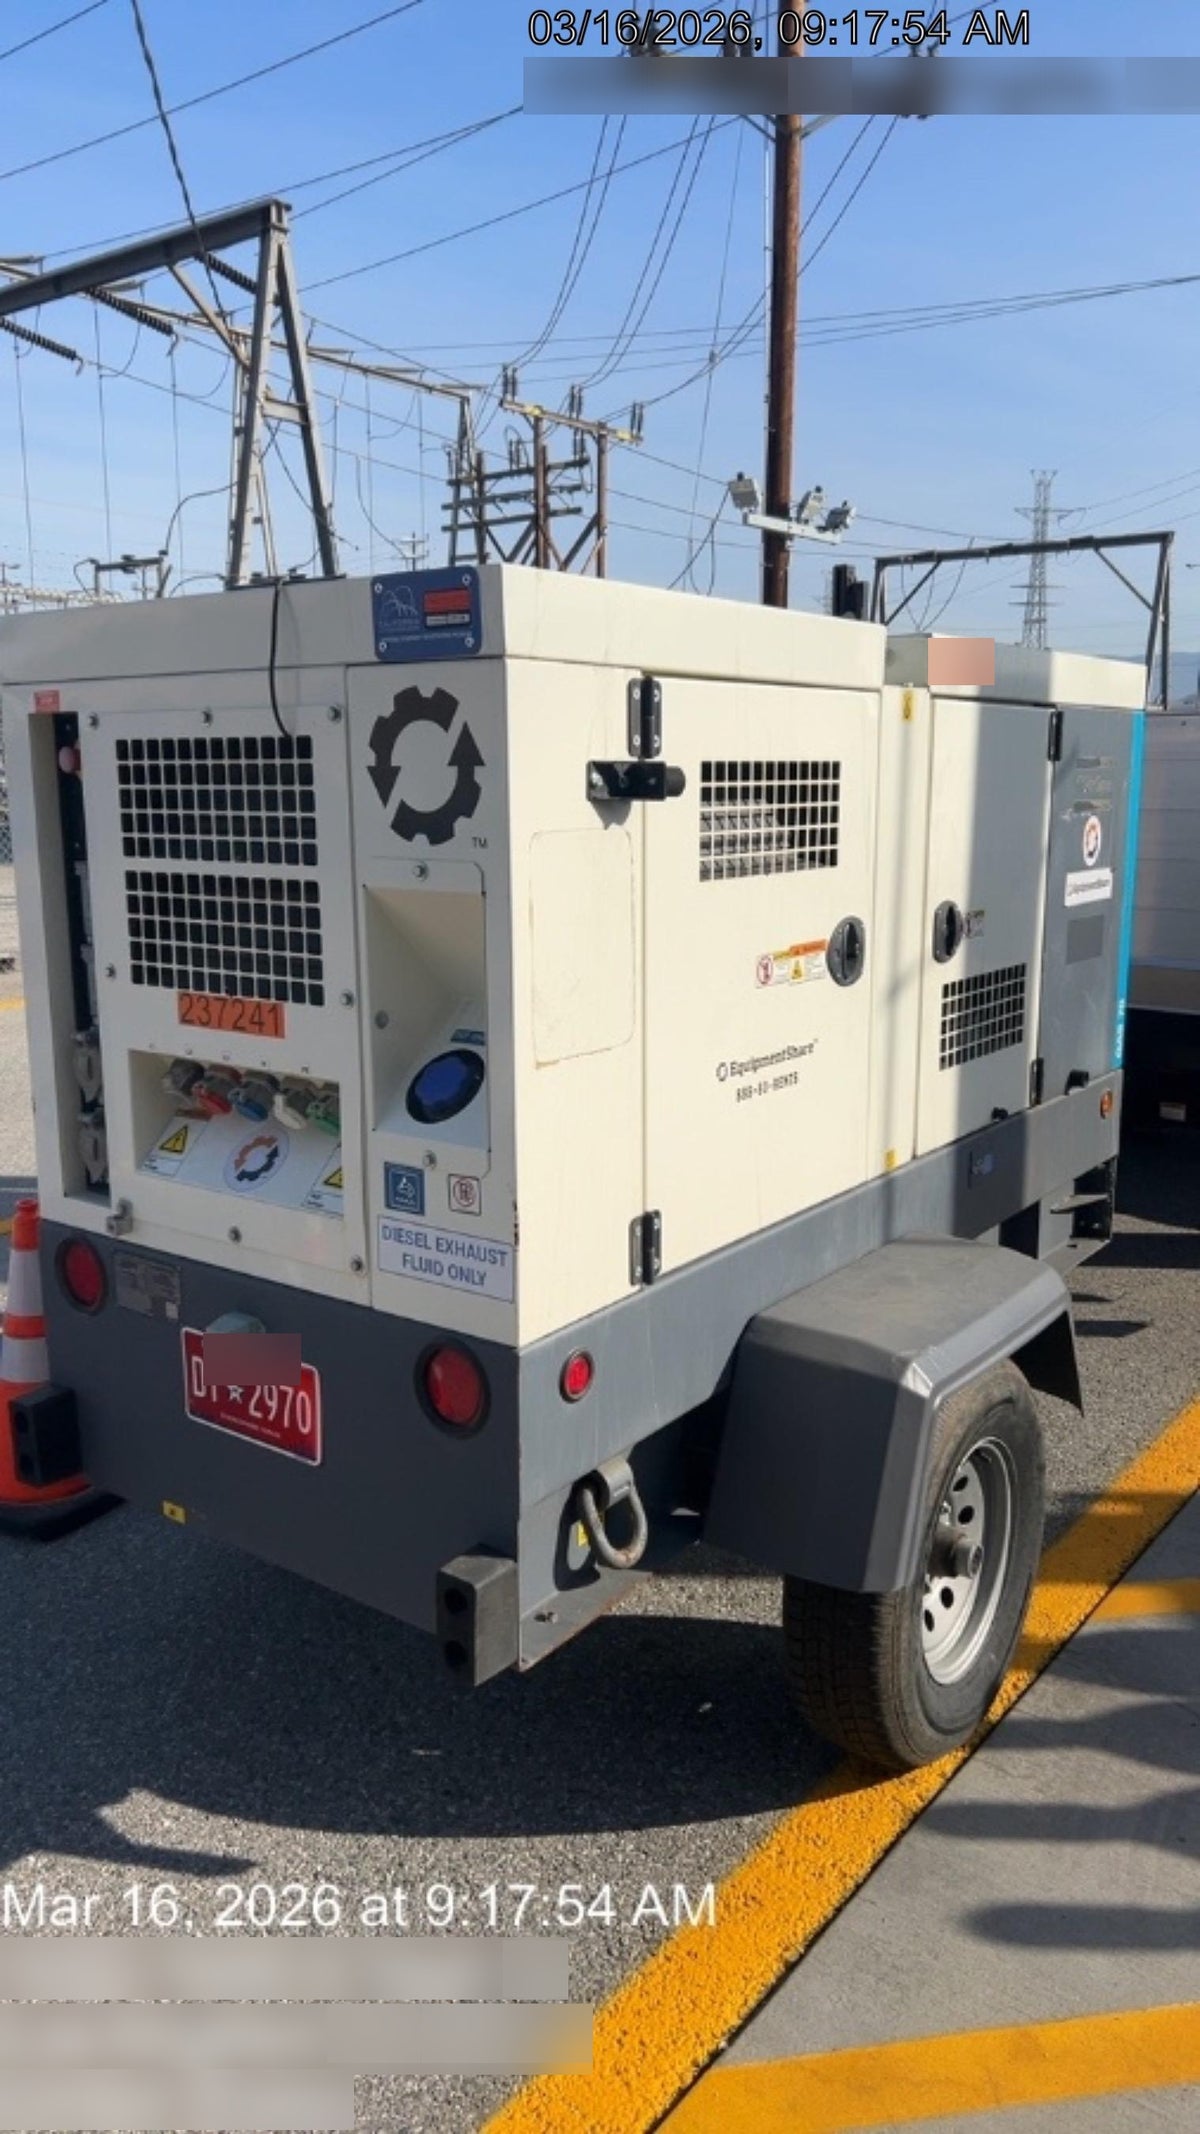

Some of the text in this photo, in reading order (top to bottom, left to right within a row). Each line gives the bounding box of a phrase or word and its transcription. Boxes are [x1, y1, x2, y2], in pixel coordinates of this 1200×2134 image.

[472, 836, 488, 848] TM
[180, 992, 279, 1036] 237241
[381, 1225, 507, 1267] DIESEL EXHAUST
[402, 1252, 486, 1286] FLUID ONLY
